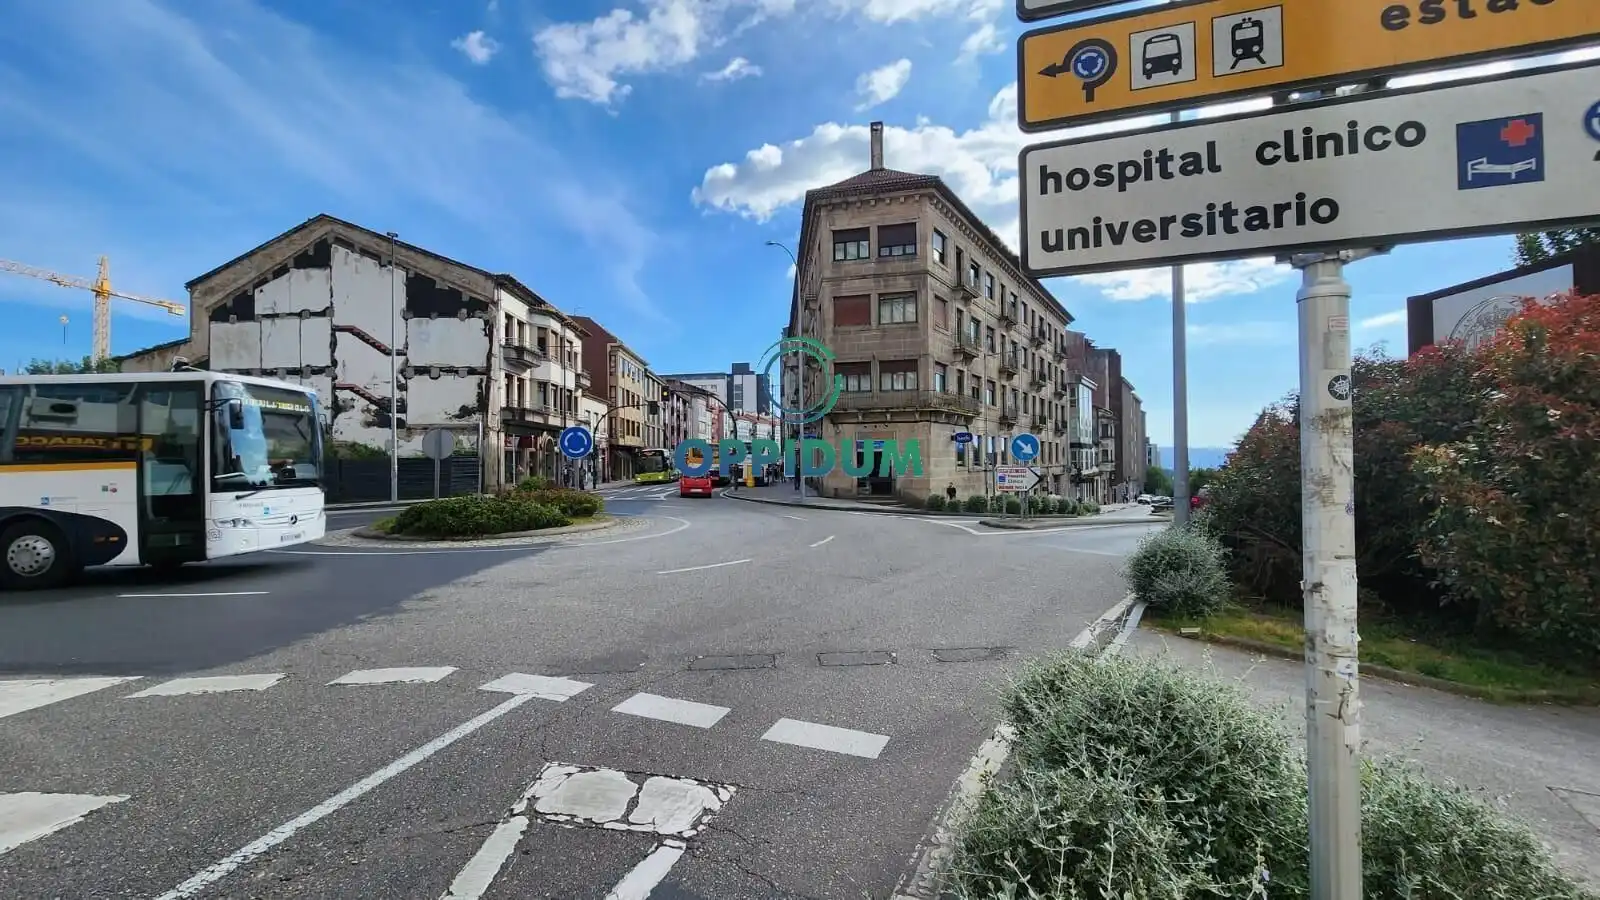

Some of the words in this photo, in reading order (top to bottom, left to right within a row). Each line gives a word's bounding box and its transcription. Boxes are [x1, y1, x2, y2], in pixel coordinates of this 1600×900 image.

[1381, 0, 1555, 31] esta
[1039, 140, 1222, 196] hospital
[1255, 119, 1427, 167] clinico
[1040, 192, 1340, 253] universitario
